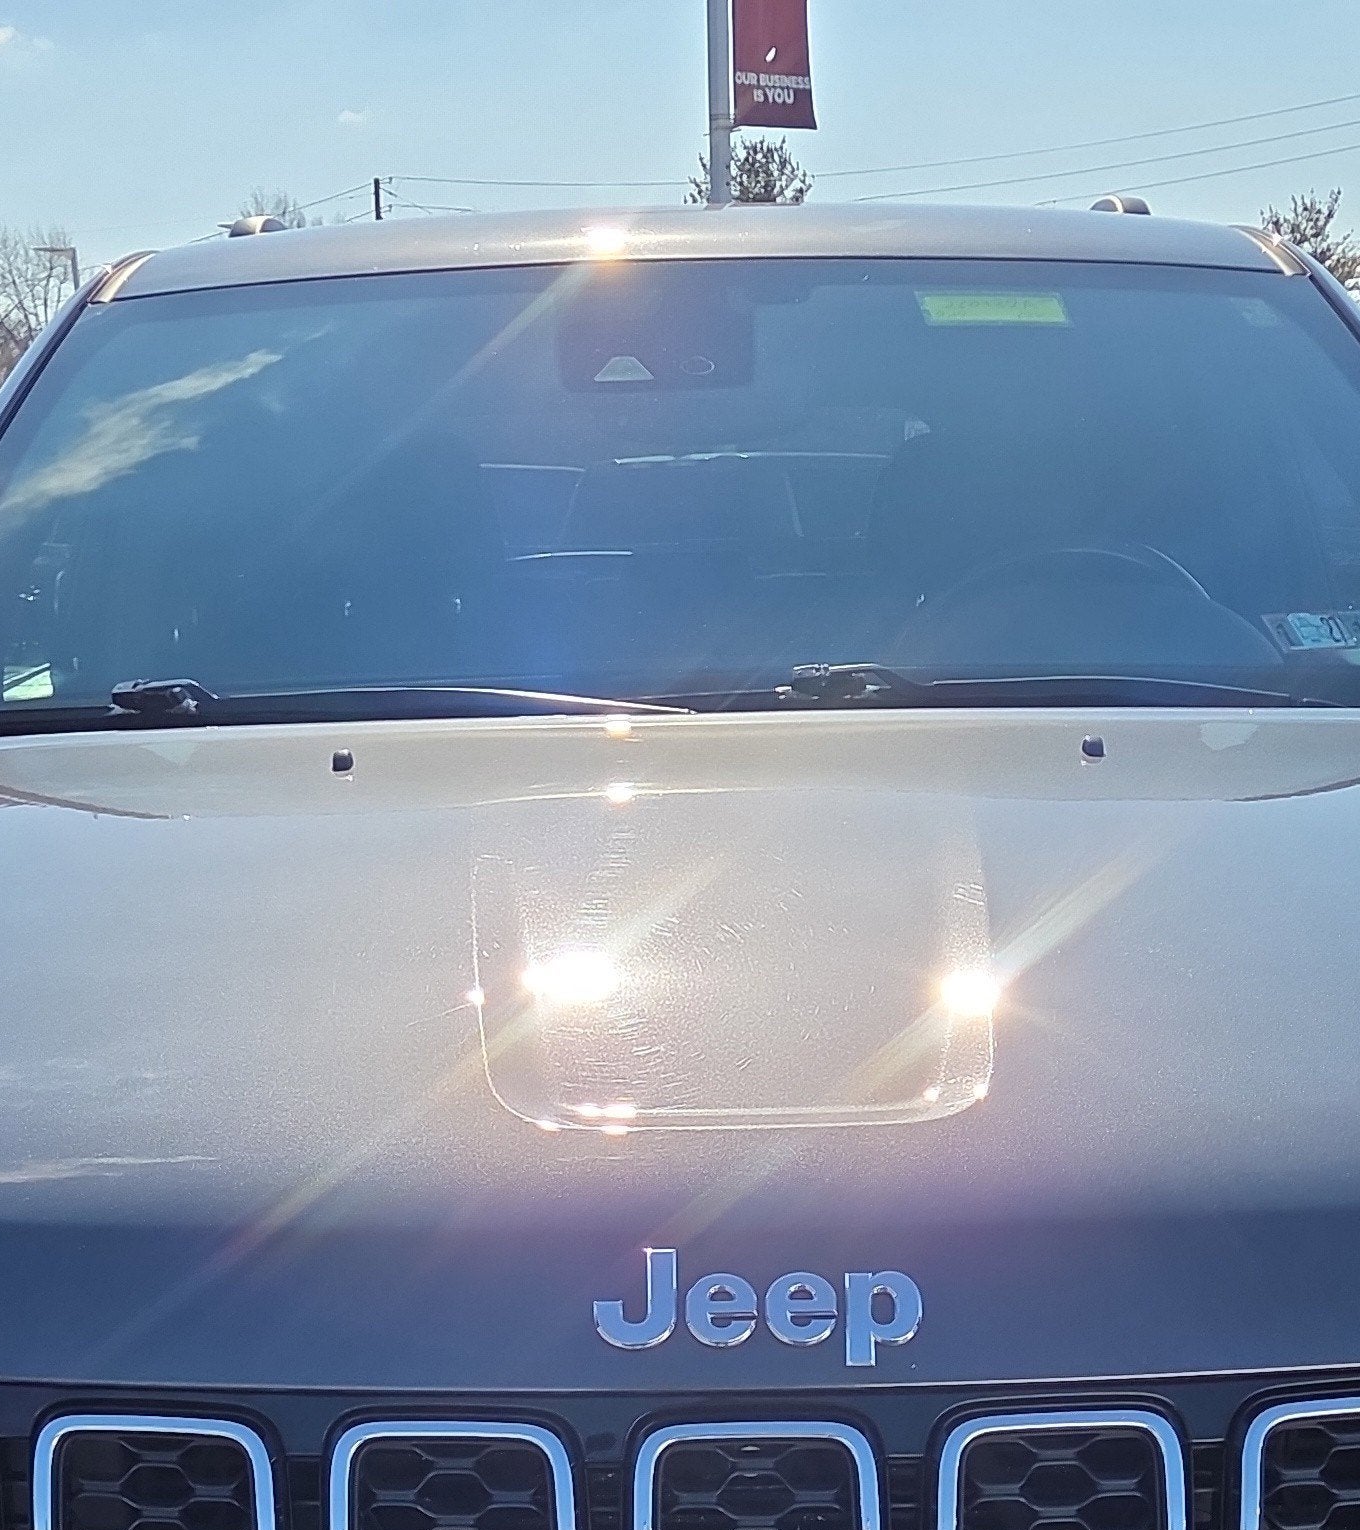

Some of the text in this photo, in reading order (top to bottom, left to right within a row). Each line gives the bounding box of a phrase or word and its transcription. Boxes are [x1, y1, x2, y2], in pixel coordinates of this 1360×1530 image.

[735, 71, 810, 89] OUR BUSINESS
[753, 88, 795, 104] IS YOU
[593, 1248, 923, 1367] Jeep
